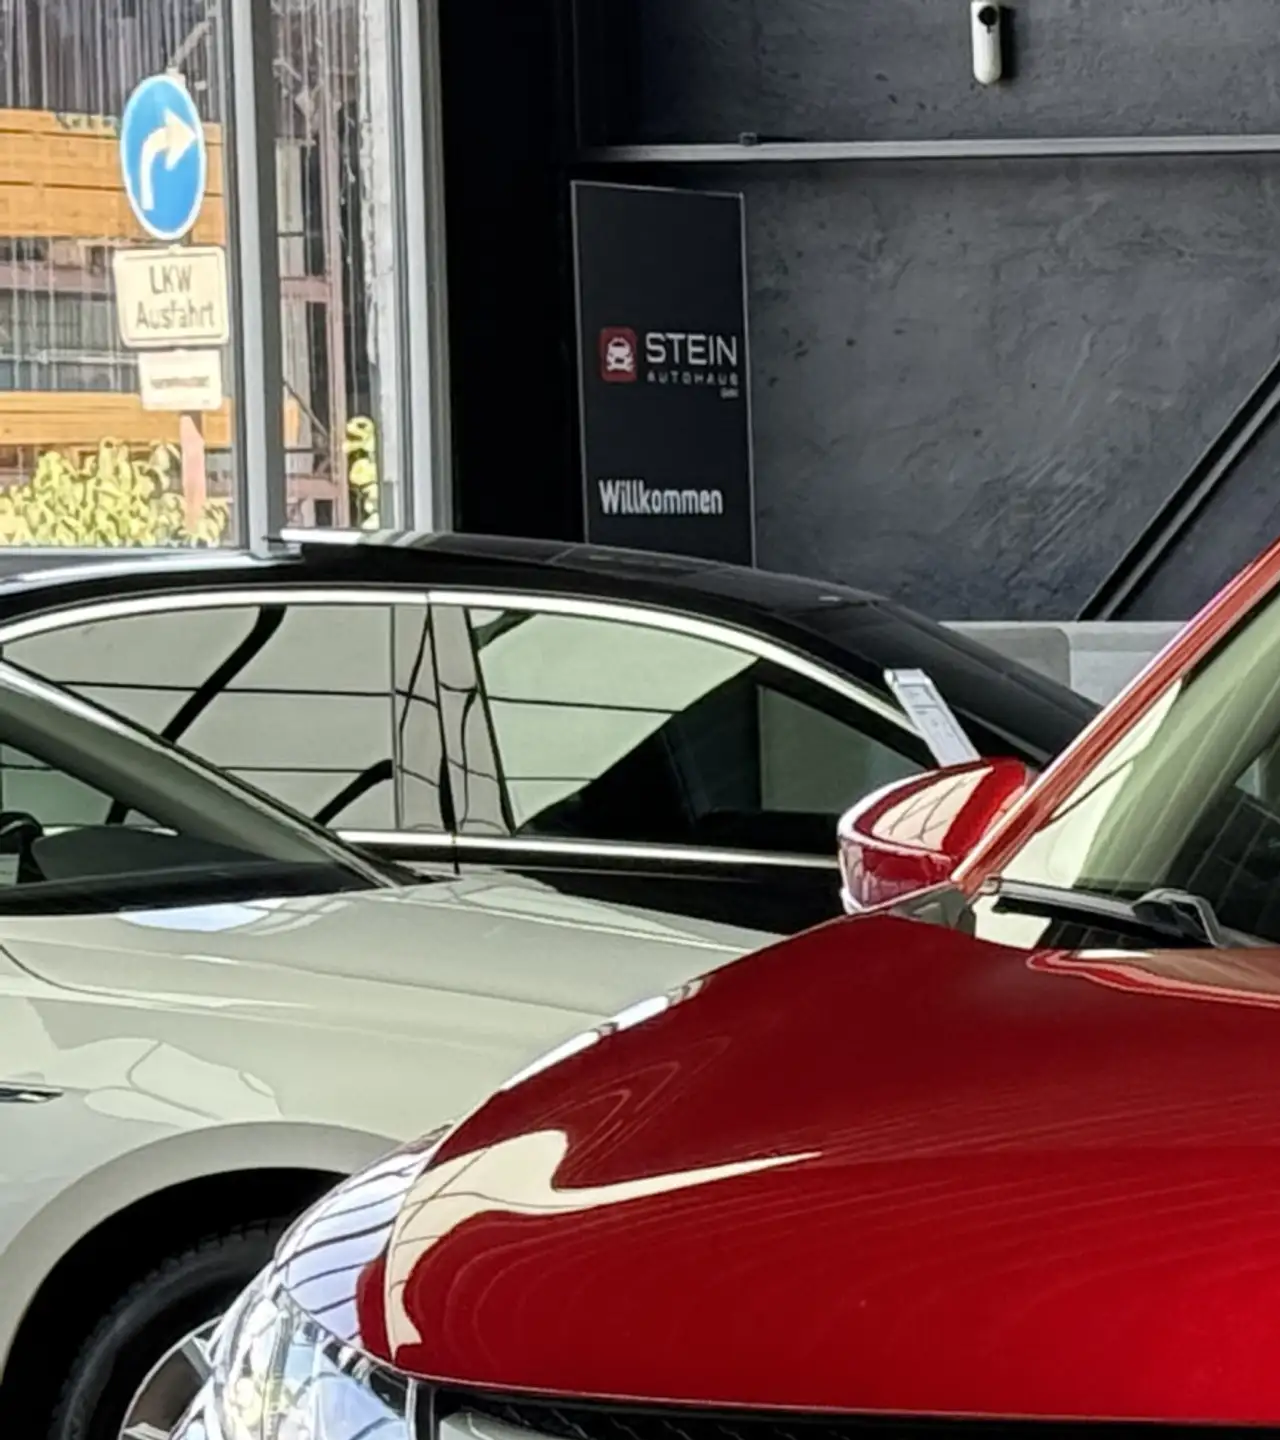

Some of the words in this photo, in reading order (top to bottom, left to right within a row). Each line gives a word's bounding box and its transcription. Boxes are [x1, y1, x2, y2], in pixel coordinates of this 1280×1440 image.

[149, 264, 192, 295] LKW
[136, 299, 216, 330] Ausfahrt
[645, 332, 738, 366] STEIN
[647, 370, 739, 386] AUTOHAUS
[599, 479, 723, 514] Willkommen
